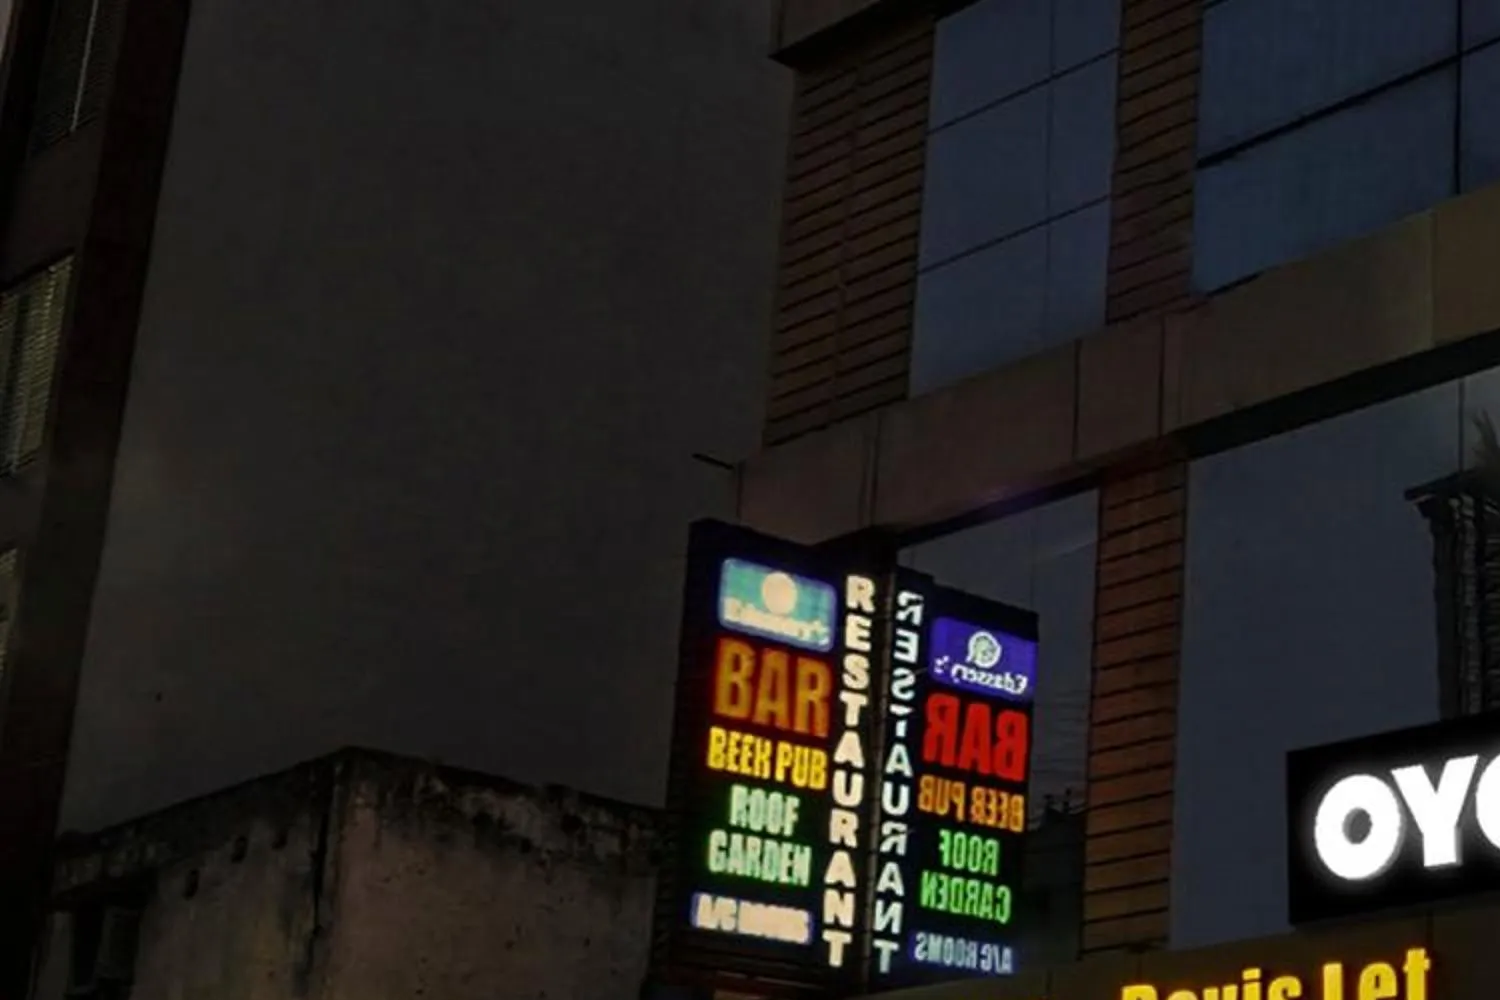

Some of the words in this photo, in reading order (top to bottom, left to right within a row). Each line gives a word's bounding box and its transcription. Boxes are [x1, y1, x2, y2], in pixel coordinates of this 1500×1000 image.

[713, 636, 832, 738] BAR
[706, 726, 772, 778] BEER
[775, 741, 828, 790] PUB
[822, 574, 876, 968] RESTAURANT
[730, 784, 800, 837] ROOF
[707, 830, 812, 887] GARDEN
